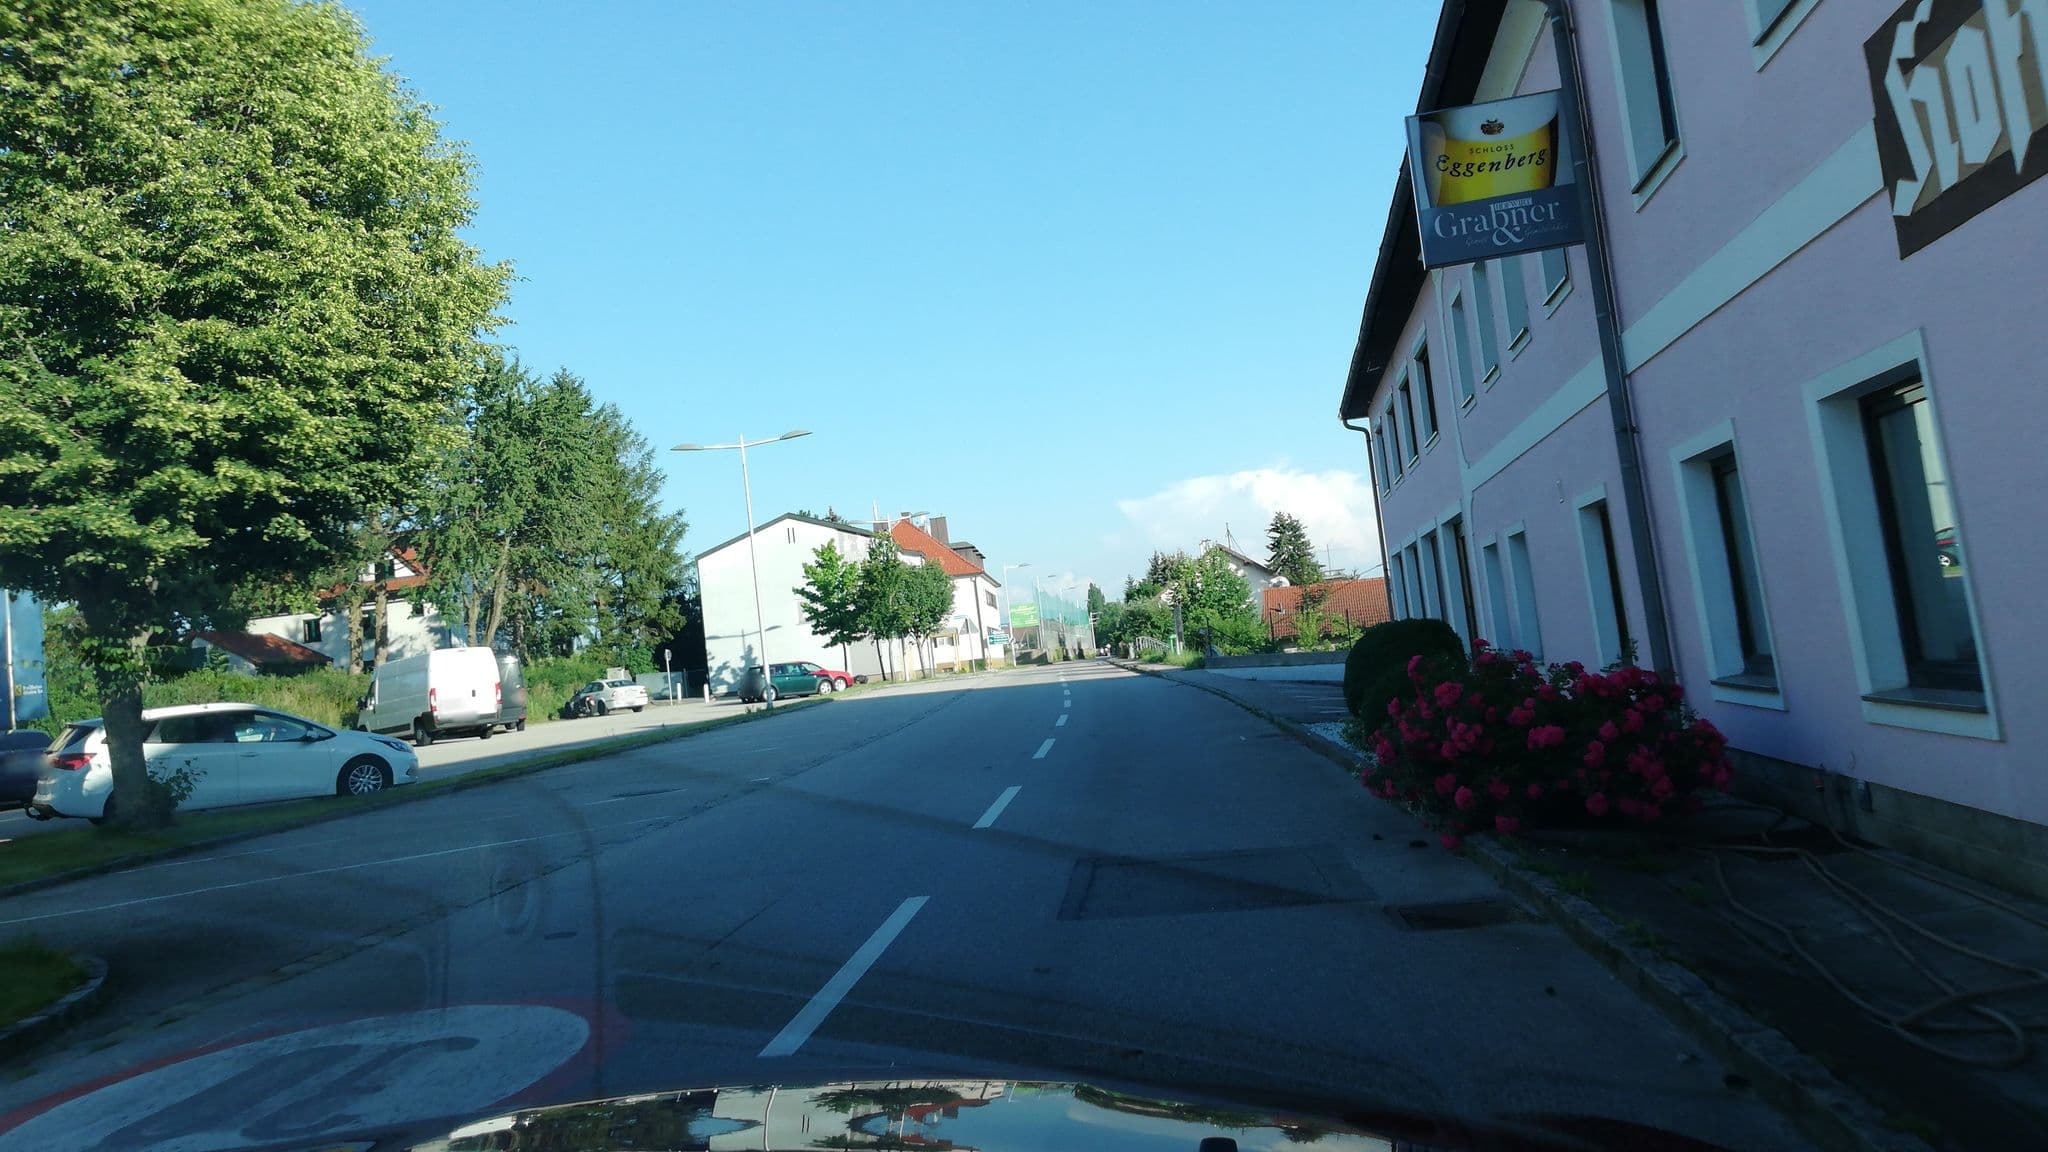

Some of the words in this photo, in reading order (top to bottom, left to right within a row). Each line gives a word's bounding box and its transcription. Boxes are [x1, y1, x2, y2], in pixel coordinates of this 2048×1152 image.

[1469, 143, 1515, 154] SCHLOSS
[1435, 148, 1547, 177] Eggenberg
[1434, 201, 1560, 238] Grabner
[1492, 225, 1524, 246] &
